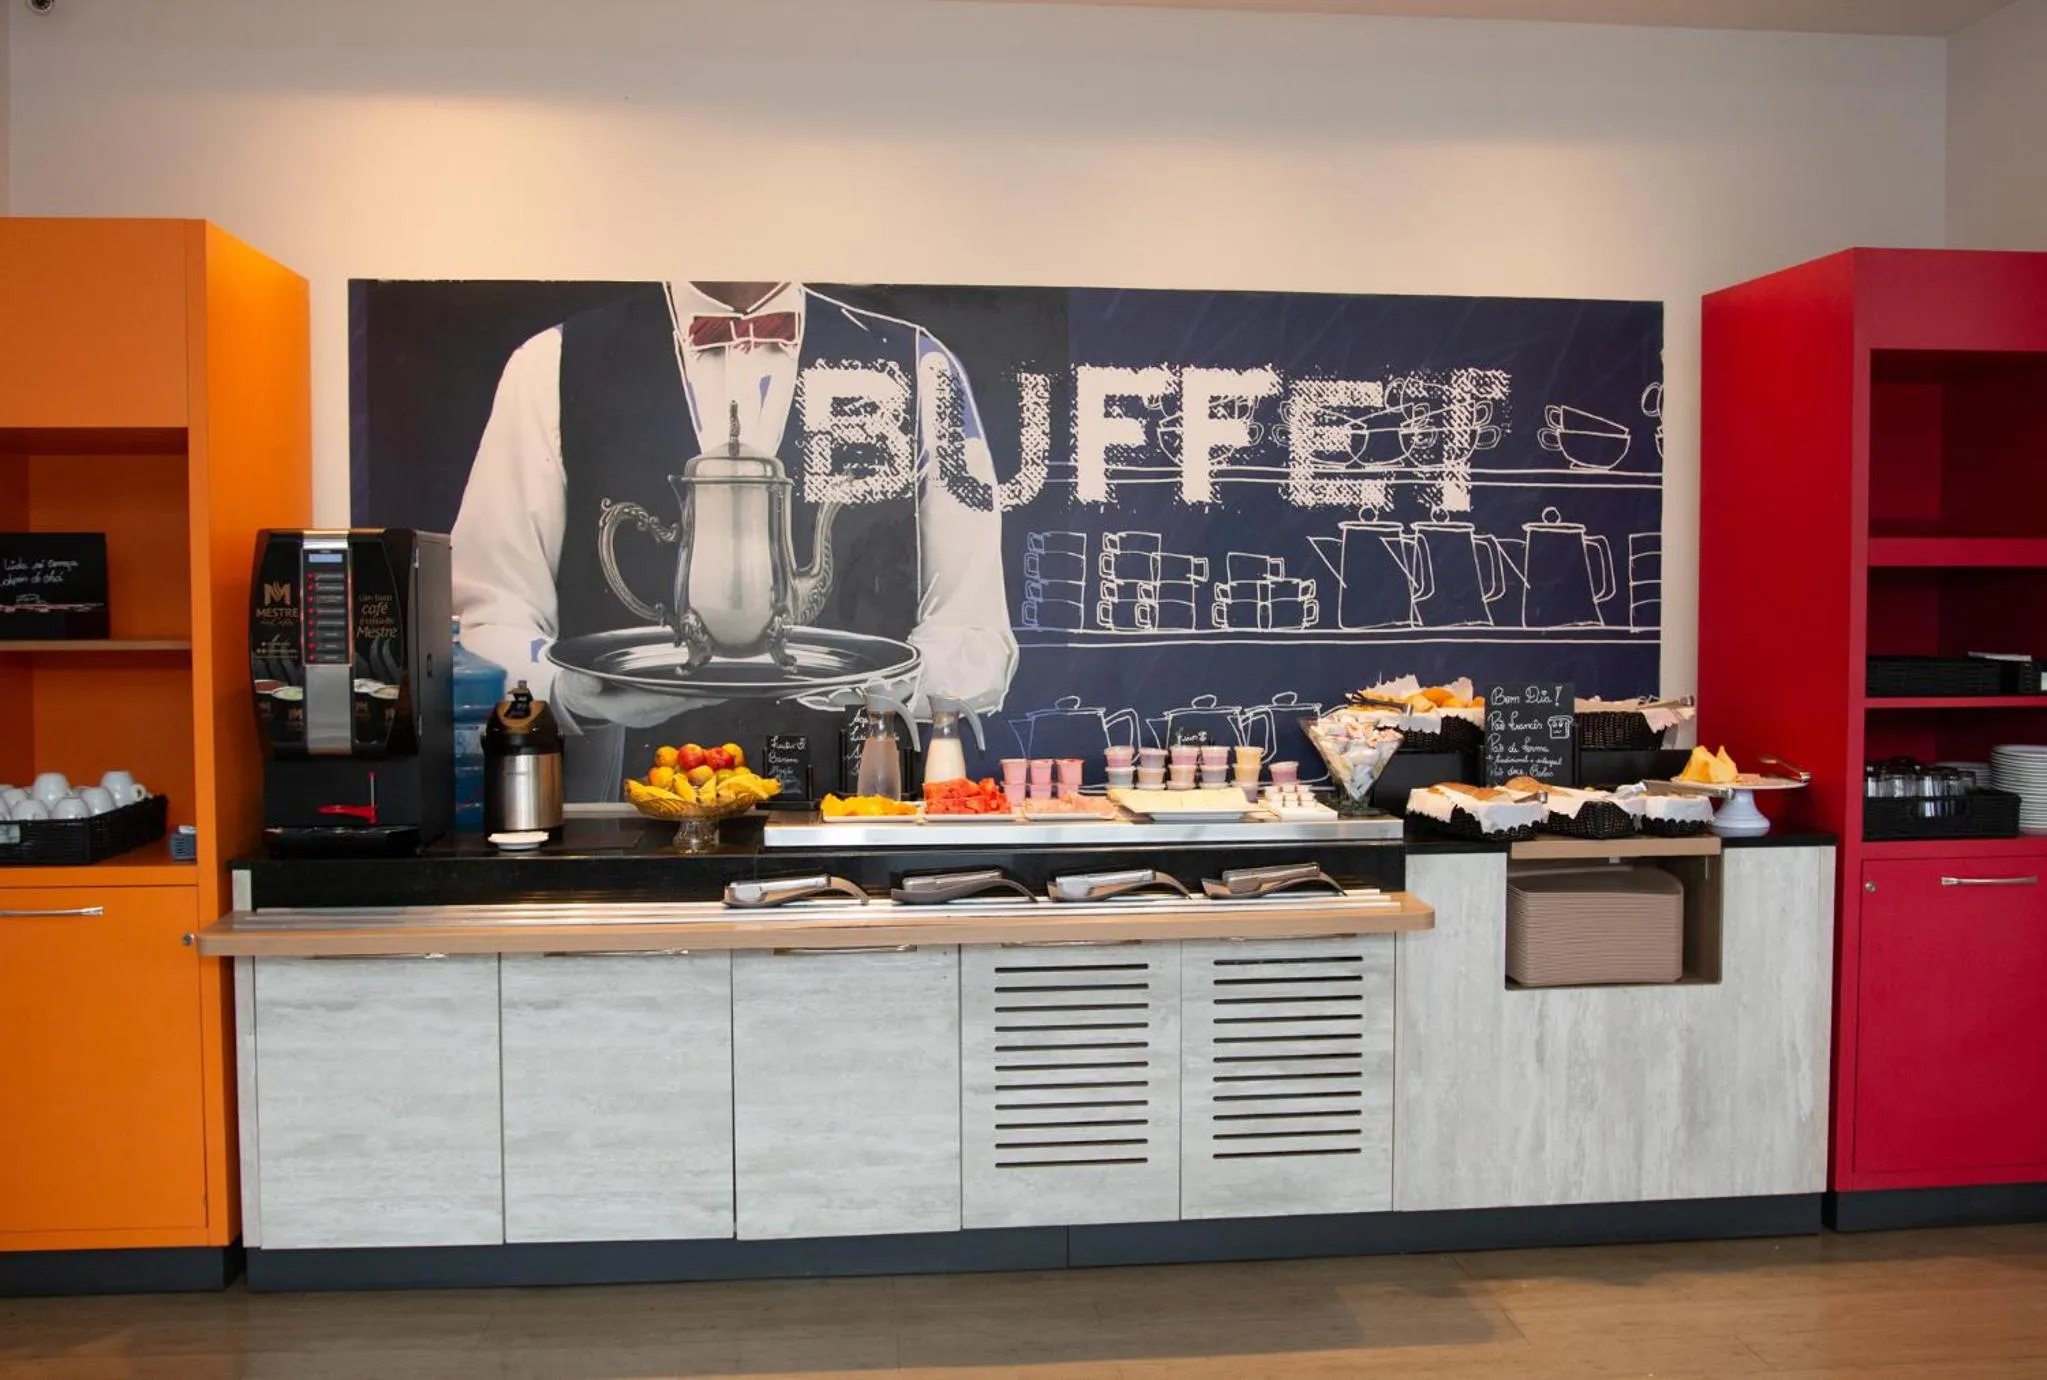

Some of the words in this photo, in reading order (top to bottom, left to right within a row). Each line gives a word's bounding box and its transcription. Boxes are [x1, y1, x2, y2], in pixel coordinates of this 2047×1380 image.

[797, 360, 1511, 511] BUFFET
[256, 607, 299, 618] MESTRE
[360, 601, 389, 618] café
[356, 625, 398, 639] Mestre
[1491, 686, 1521, 706] Bom
